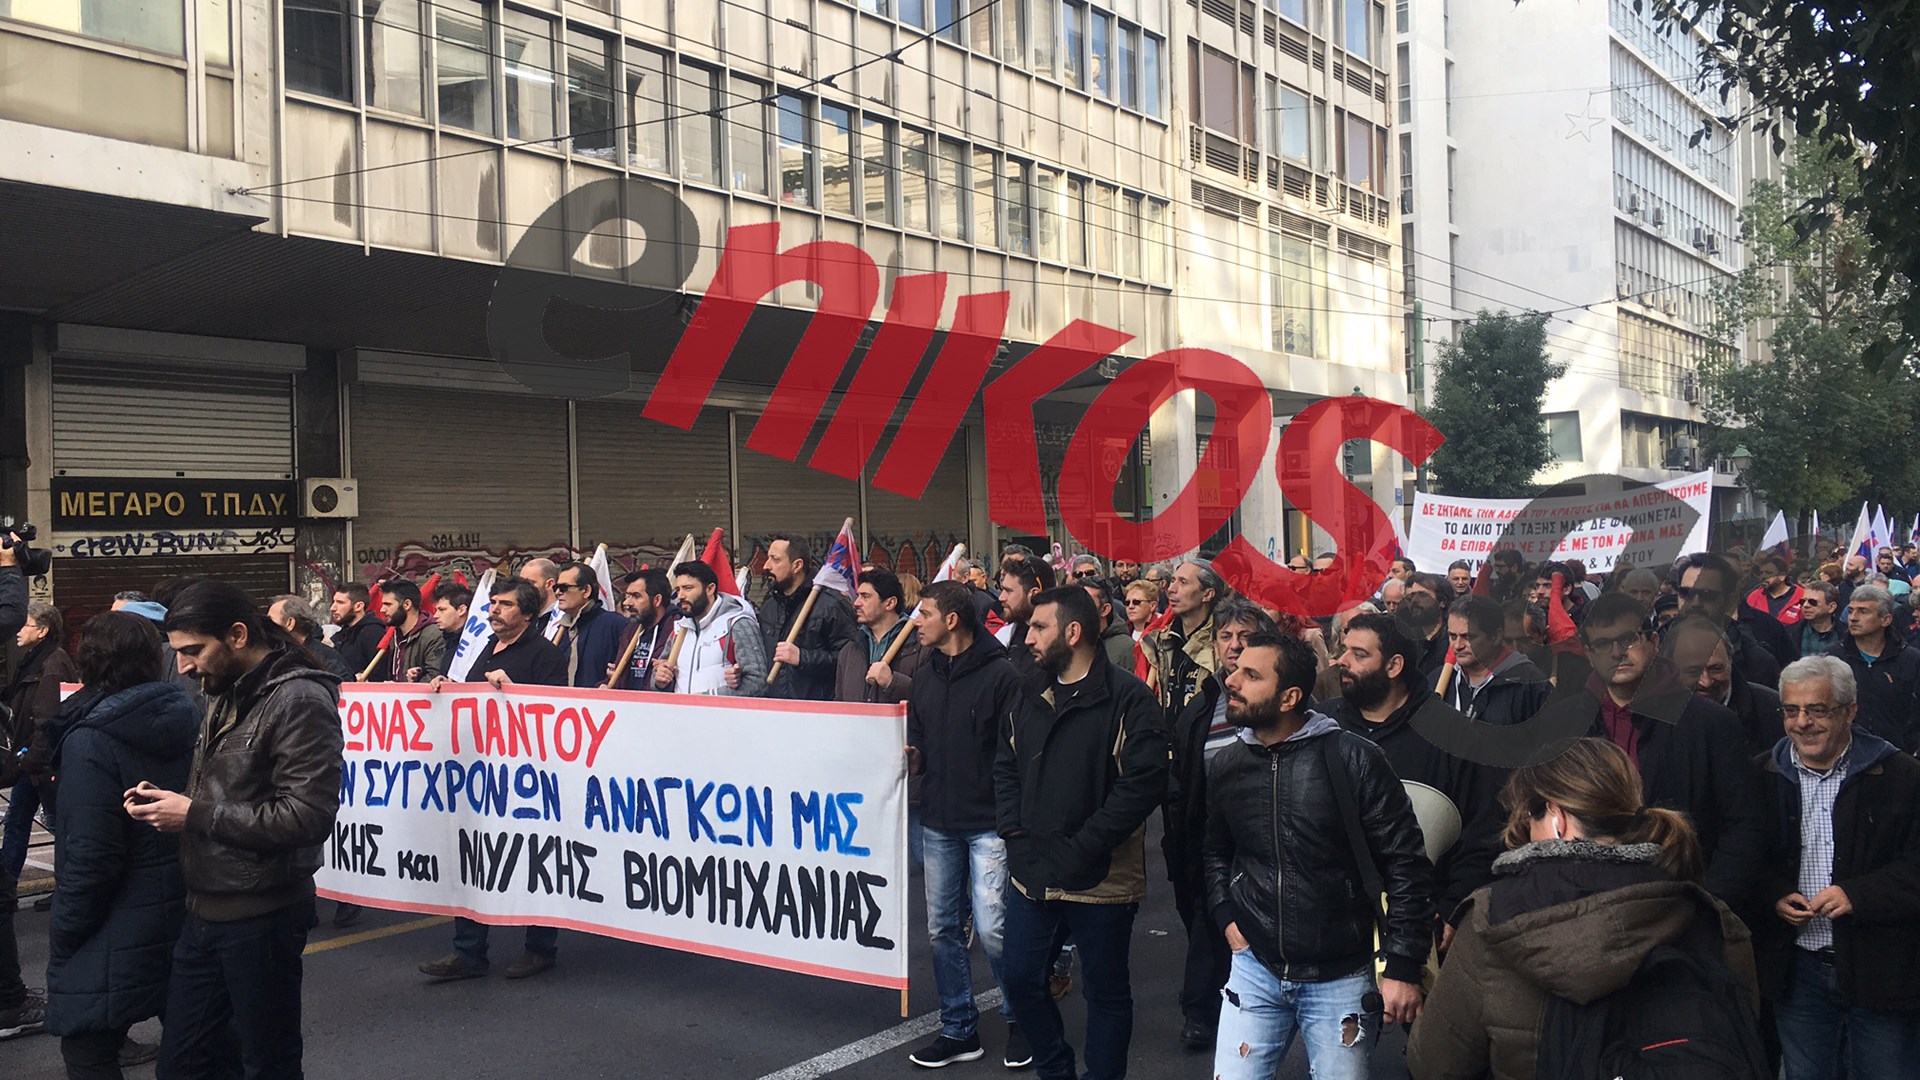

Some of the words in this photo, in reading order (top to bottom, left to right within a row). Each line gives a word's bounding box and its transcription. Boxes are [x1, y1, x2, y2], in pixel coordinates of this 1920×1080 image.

[60, 491, 185, 517] ΜΕΓΑΡΟ
[201, 491, 288, 516] Τ.Π.Δ.Υ.
[1422, 503, 1434, 515] ΔΕ
[1437, 503, 1473, 518] ΖΗΤΑΜΕ
[1441, 538, 1456, 551] ΘΑ
[1572, 537, 1588, 551] ΜΕ
[1592, 535, 1613, 549] ΤΟΝ
[1659, 523, 1684, 538] ΜΑΣ
[1444, 522, 1457, 535] ΤΟ
[1461, 522, 1492, 535] ΔΙΚΙΟ
[1495, 523, 1515, 536] ΤΗΣ
[1521, 521, 1556, 535] ΤΑΞΗΣ
[1560, 519, 1584, 533] ΜΑΣ
[1590, 518, 1606, 531] ΔΕ
[1589, 557, 1598, 569] &
[451, 697, 616, 768] ΠΑΝΤΟΥ
[364, 759, 561, 822] ΣΥΓΧΡΟΝΩΝ
[584, 775, 773, 847] ΑΝΑΓΚΩΝ
[790, 790, 871, 857] ΜΑΣ
[398, 850, 439, 883] και
[623, 850, 895, 950] ΒΙΟΜΗΧΑΝΙΑΣ
